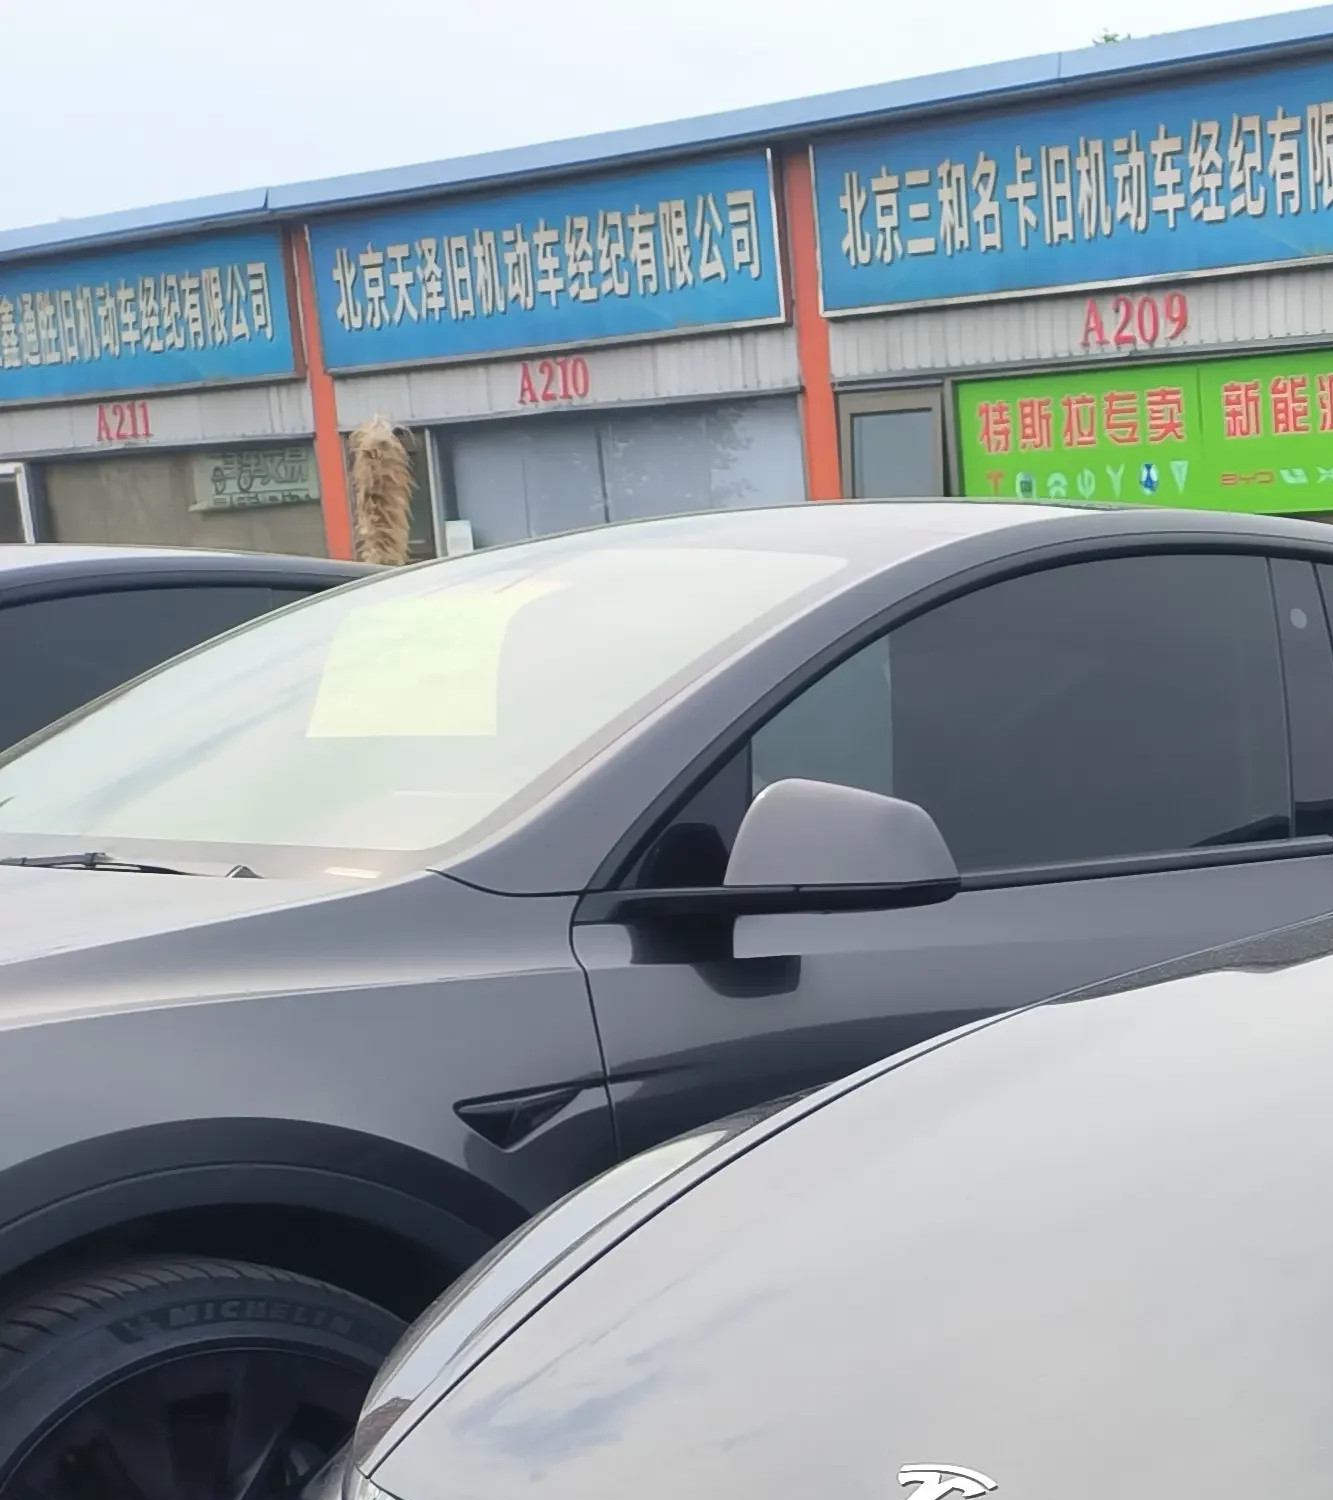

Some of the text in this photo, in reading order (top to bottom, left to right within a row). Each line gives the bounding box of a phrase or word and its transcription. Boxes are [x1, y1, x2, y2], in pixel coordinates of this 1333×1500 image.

[332, 189, 762, 332] 北京天泽旧机动车经纪有限公司
[1081, 292, 1188, 348] A209
[517, 356, 591, 406] A210
[97, 402, 153, 441] A211
[977, 385, 1187, 456] 特斯拉专卖
[169, 1300, 353, 1336] MICHELIN
